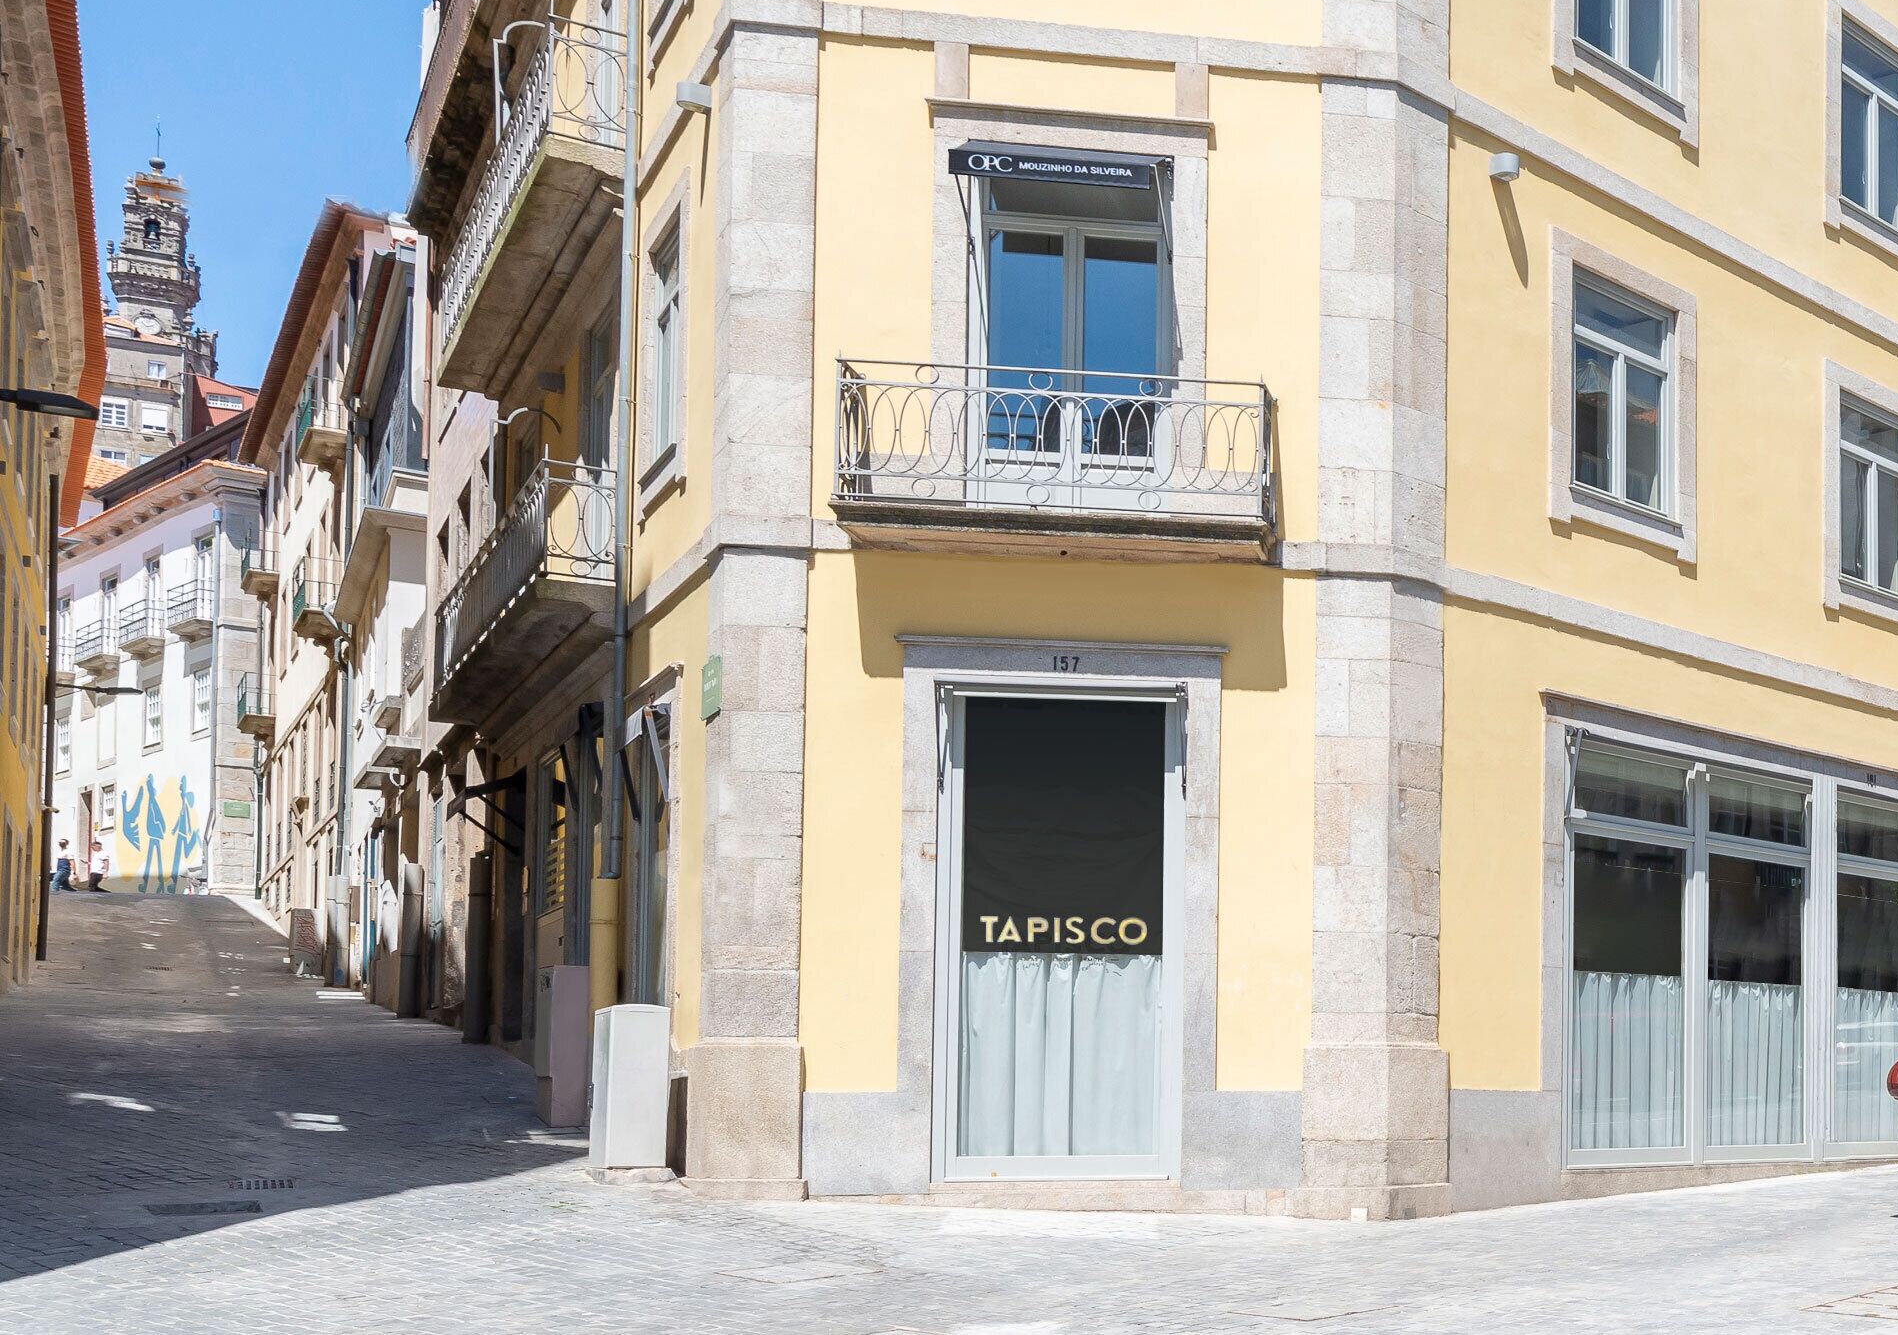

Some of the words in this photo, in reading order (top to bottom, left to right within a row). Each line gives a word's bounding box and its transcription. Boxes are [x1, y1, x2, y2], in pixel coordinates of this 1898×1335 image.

[968, 154, 1013, 173] OPC
[1018, 161, 1073, 174] MOUZINHO
[1074, 164, 1088, 174] DA
[1090, 166, 1133, 177] SILVEIRA
[1052, 655, 1081, 673] 157
[980, 914, 1149, 946] TAPISCO
